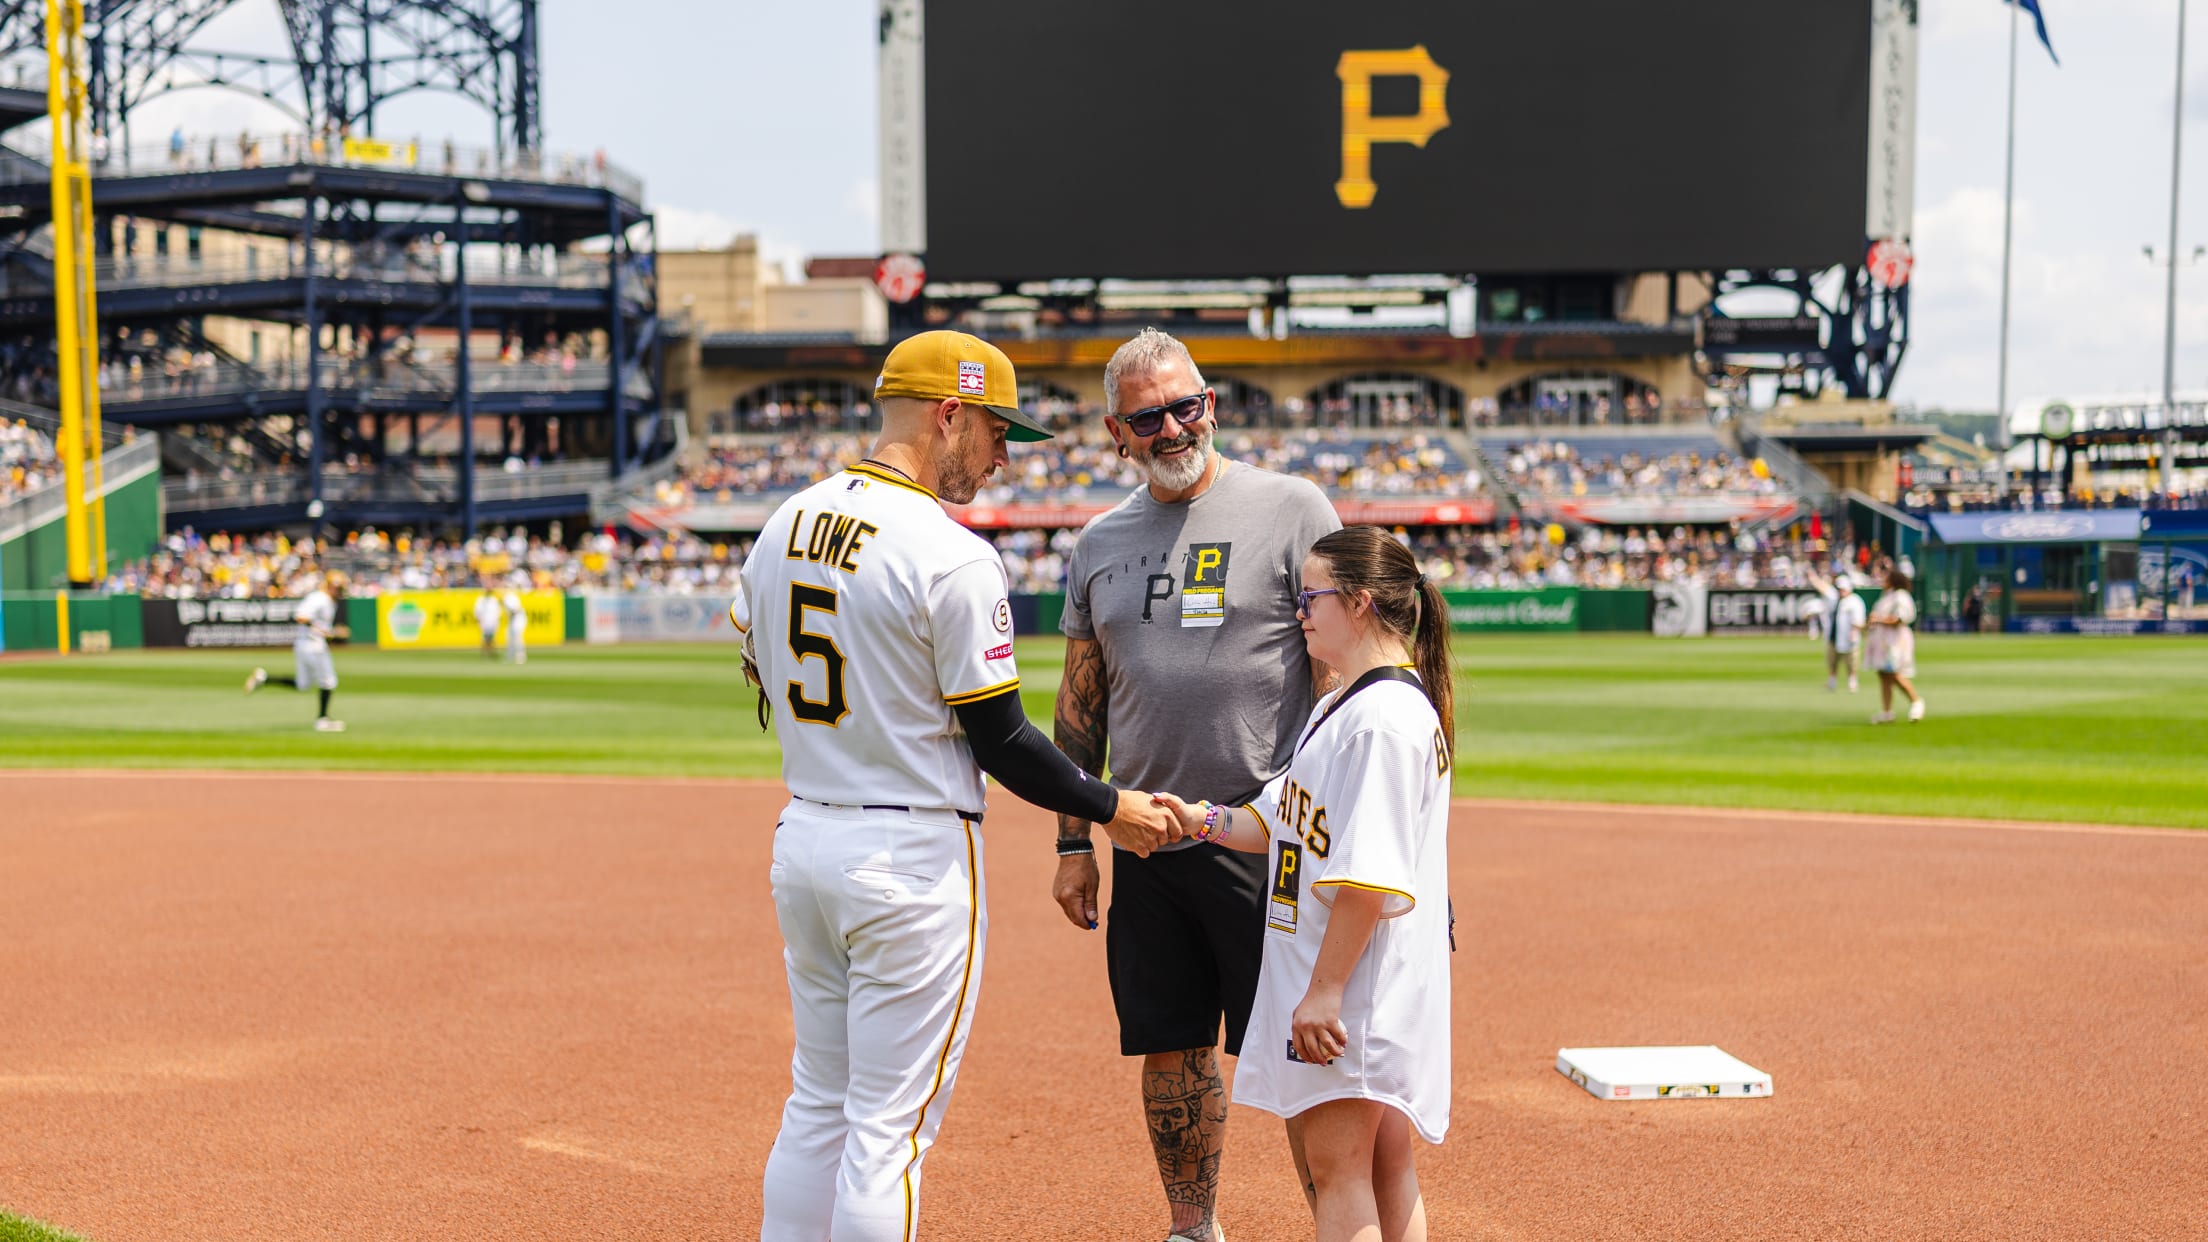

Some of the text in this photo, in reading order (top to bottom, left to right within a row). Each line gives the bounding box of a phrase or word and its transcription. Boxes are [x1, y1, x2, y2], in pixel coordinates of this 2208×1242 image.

[1334, 45, 1451, 209] P
[786, 509, 879, 574] LOWE
[1194, 548, 1222, 582] P
[1000, 604, 1008, 626] 9
[1142, 572, 1176, 620] P
[786, 580, 852, 728] 5
[1279, 849, 1297, 888] P
